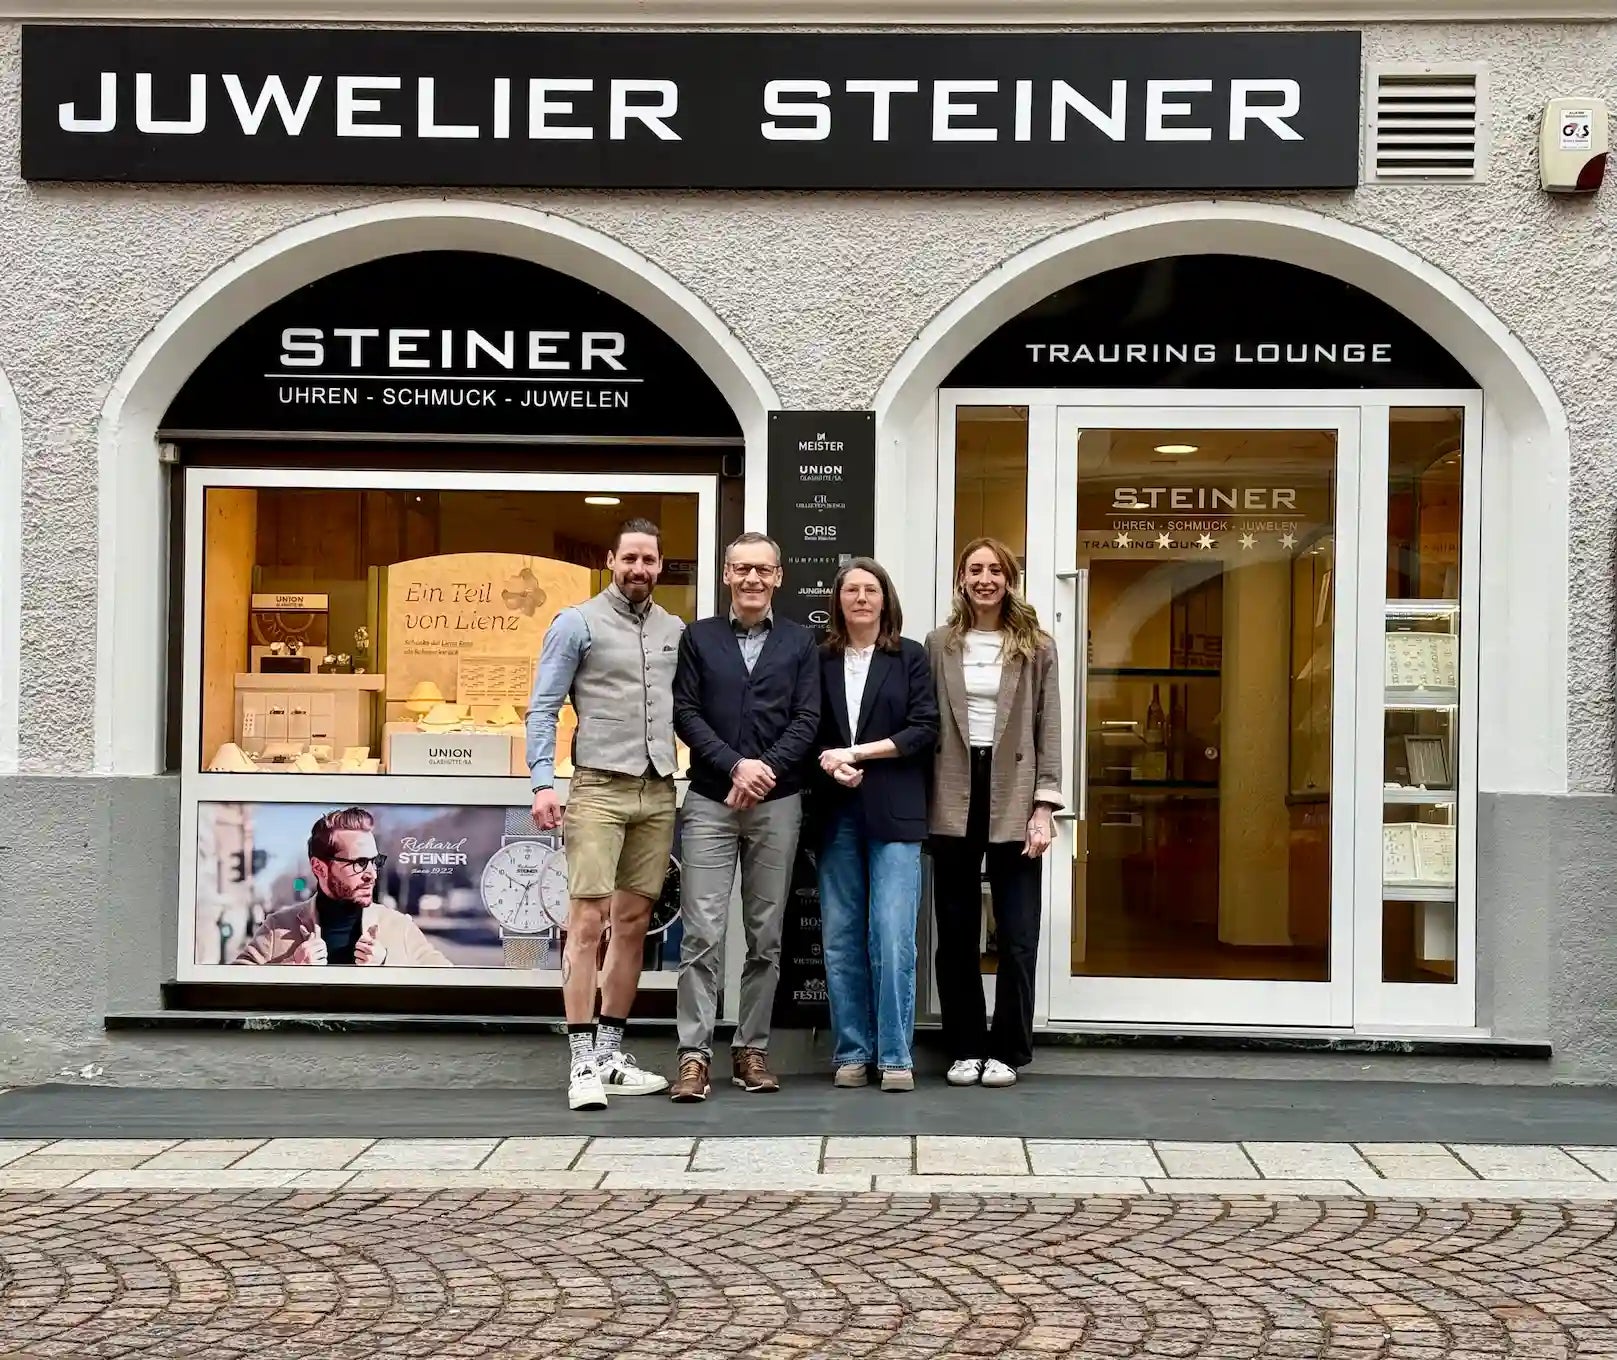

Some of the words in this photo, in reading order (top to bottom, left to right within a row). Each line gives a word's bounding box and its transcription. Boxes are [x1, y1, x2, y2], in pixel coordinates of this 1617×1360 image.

[59, 72, 682, 141] JUWELIER
[761, 79, 1304, 141] STEINER
[280, 328, 627, 371] STEINER
[1026, 344, 1216, 362] TRAURING
[1236, 344, 1392, 362] LOUNGE
[279, 387, 357, 405] UHREN
[382, 387, 497, 407] SCHMUCK
[520, 388, 628, 408] JUWELEN
[799, 441, 844, 451] MEISTER
[799, 465, 843, 474] UNION
[1113, 487, 1297, 510] STEINER
[804, 525, 837, 536] ORIS
[1113, 520, 1155, 531] UHREN
[1167, 520, 1228, 531] SCHMUCK
[1239, 520, 1298, 532] JUWELEN
[1083, 540, 1154, 549] TRAUING
[1160, 540, 1219, 549] OUNE
[404, 582, 444, 603] Ein
[451, 582, 492, 603] Teil
[276, 595, 304, 603] UNION
[404, 614, 449, 630] von
[454, 610, 521, 631] Lienz
[429, 748, 472, 758] UNION
[400, 837, 467, 852] Richard
[398, 852, 467, 865] STEINER
[431, 867, 454, 875] 1922
[793, 991, 829, 1000] FESTIN
